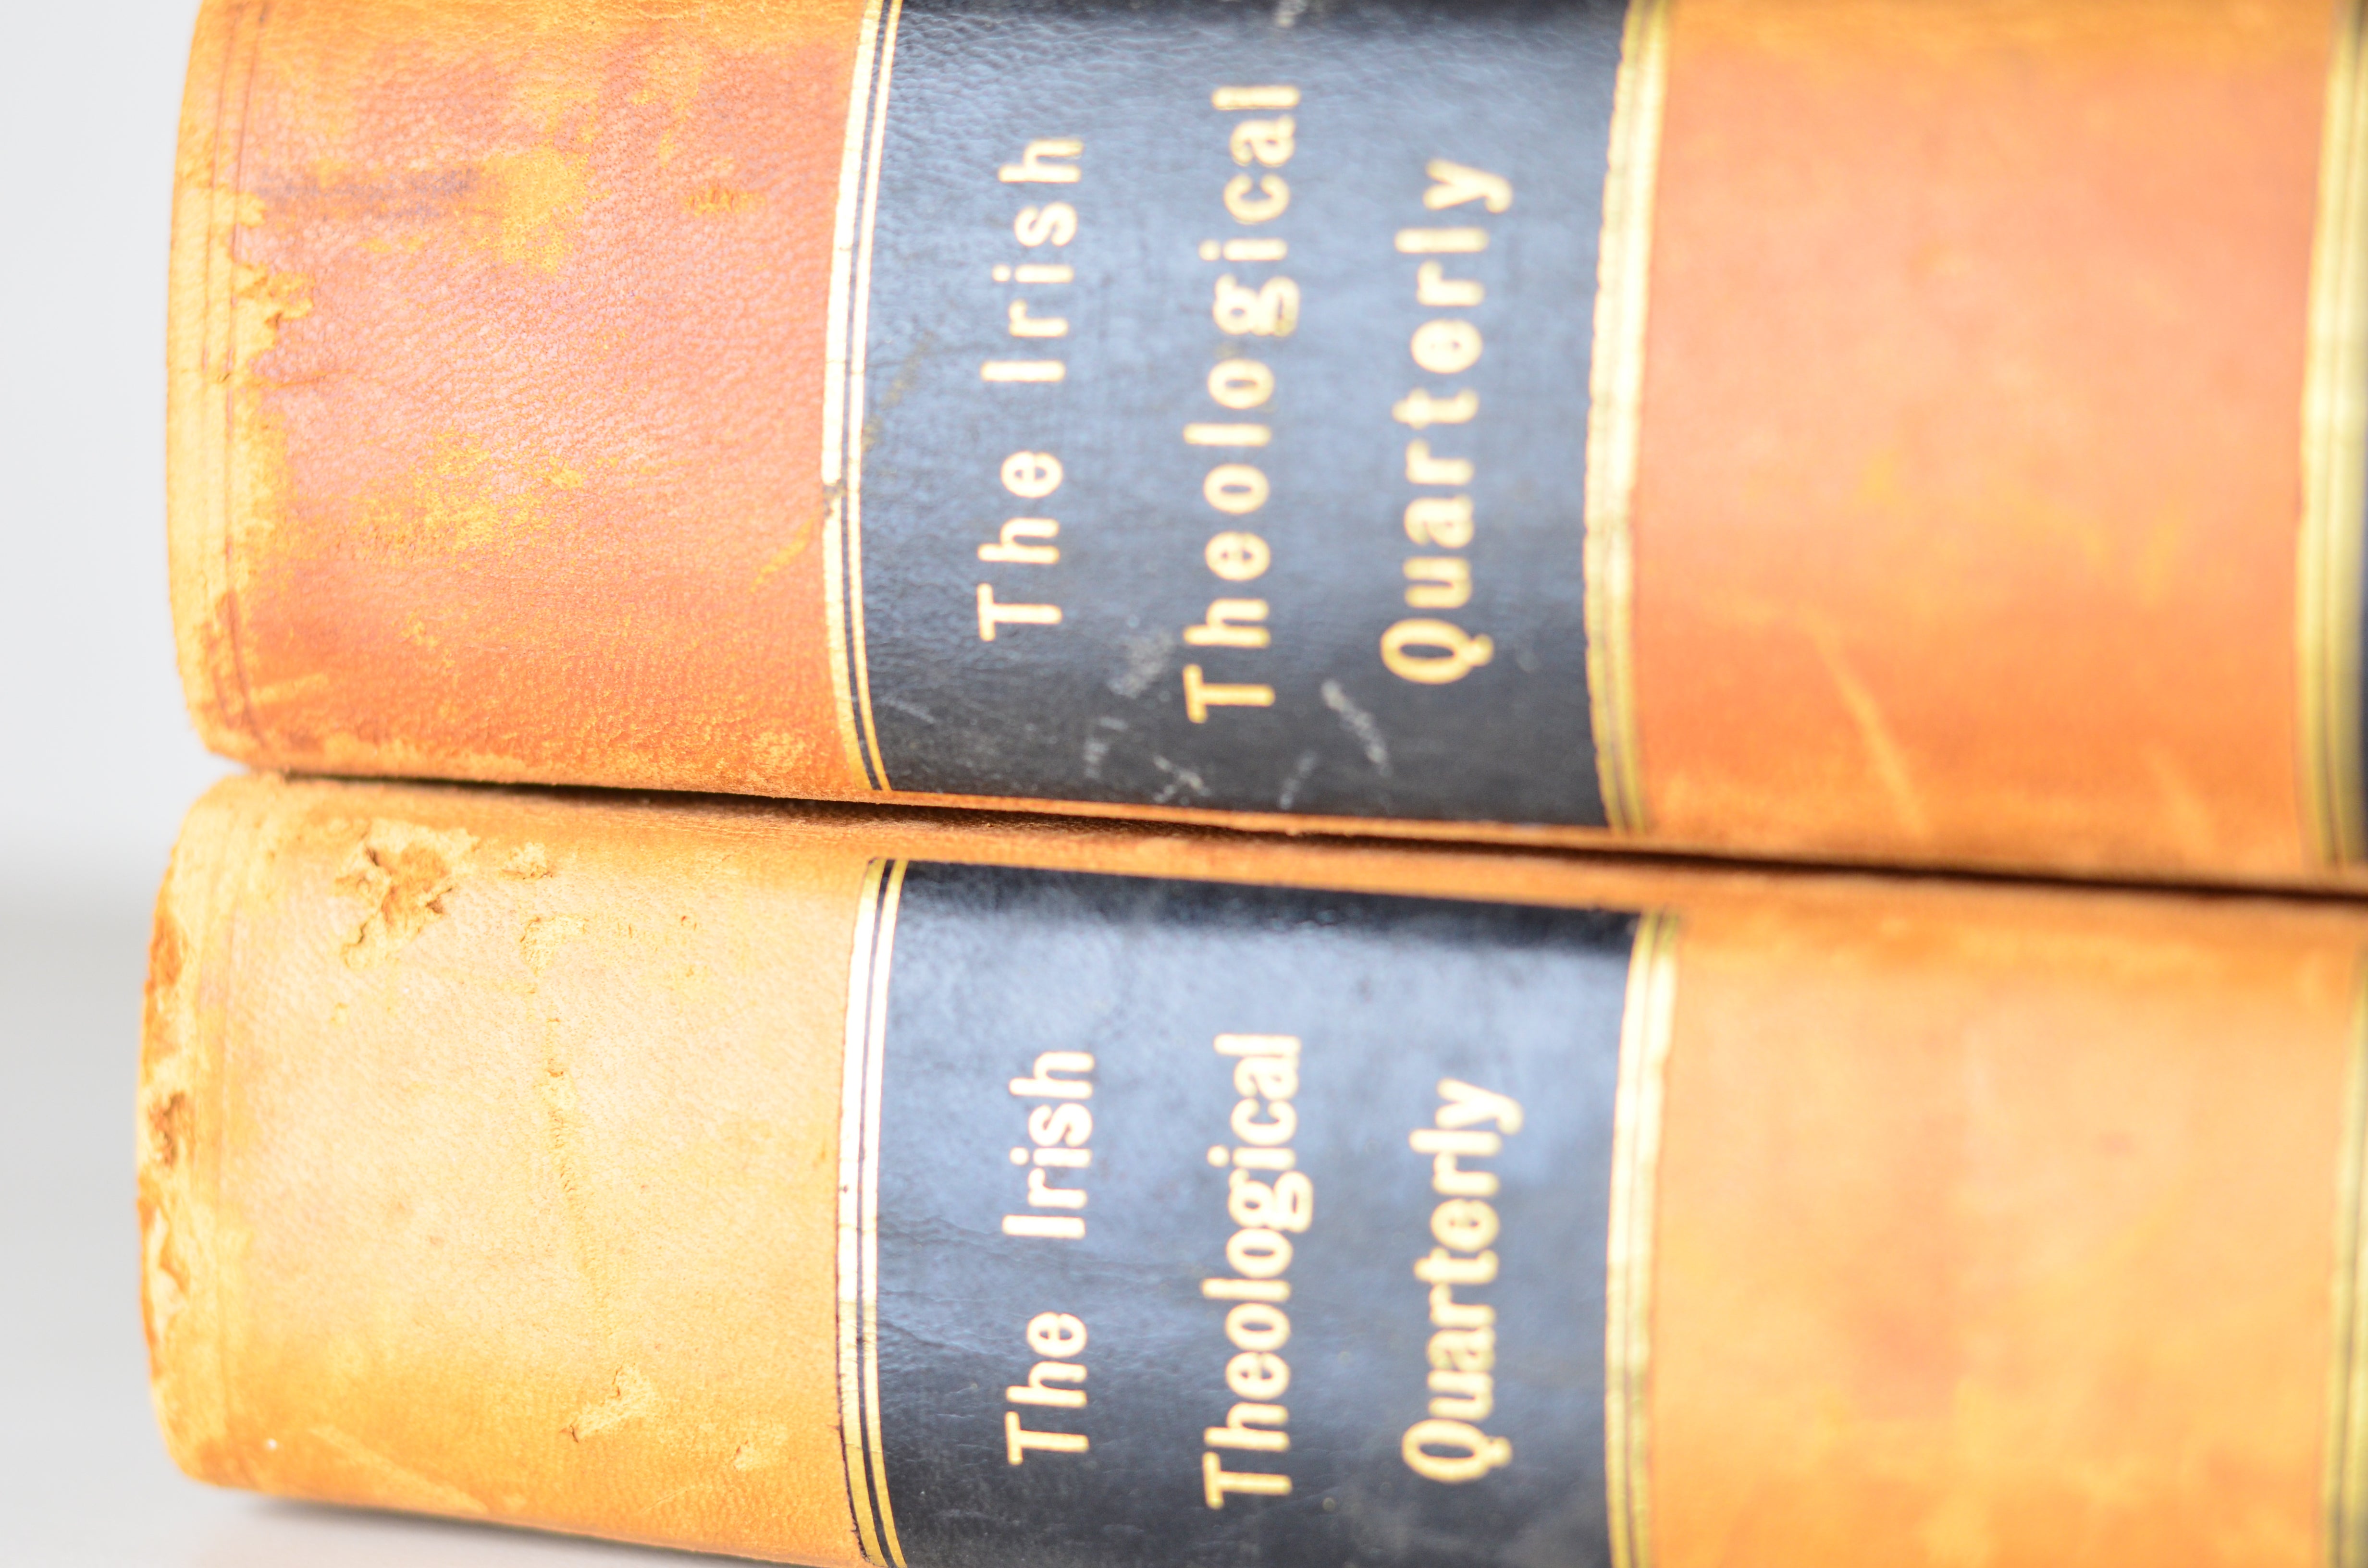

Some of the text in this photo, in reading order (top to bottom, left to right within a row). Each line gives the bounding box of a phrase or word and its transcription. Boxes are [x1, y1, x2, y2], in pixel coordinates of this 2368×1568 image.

[977, 138, 1084, 642] The Irish
[1182, 85, 1301, 723] Theological
[1380, 158, 1513, 685] Quarterly
[1002, 1051, 1095, 1465] The Irish
[1199, 1033, 1314, 1509] Theological
[1402, 1078, 1524, 1483] Quarterly
